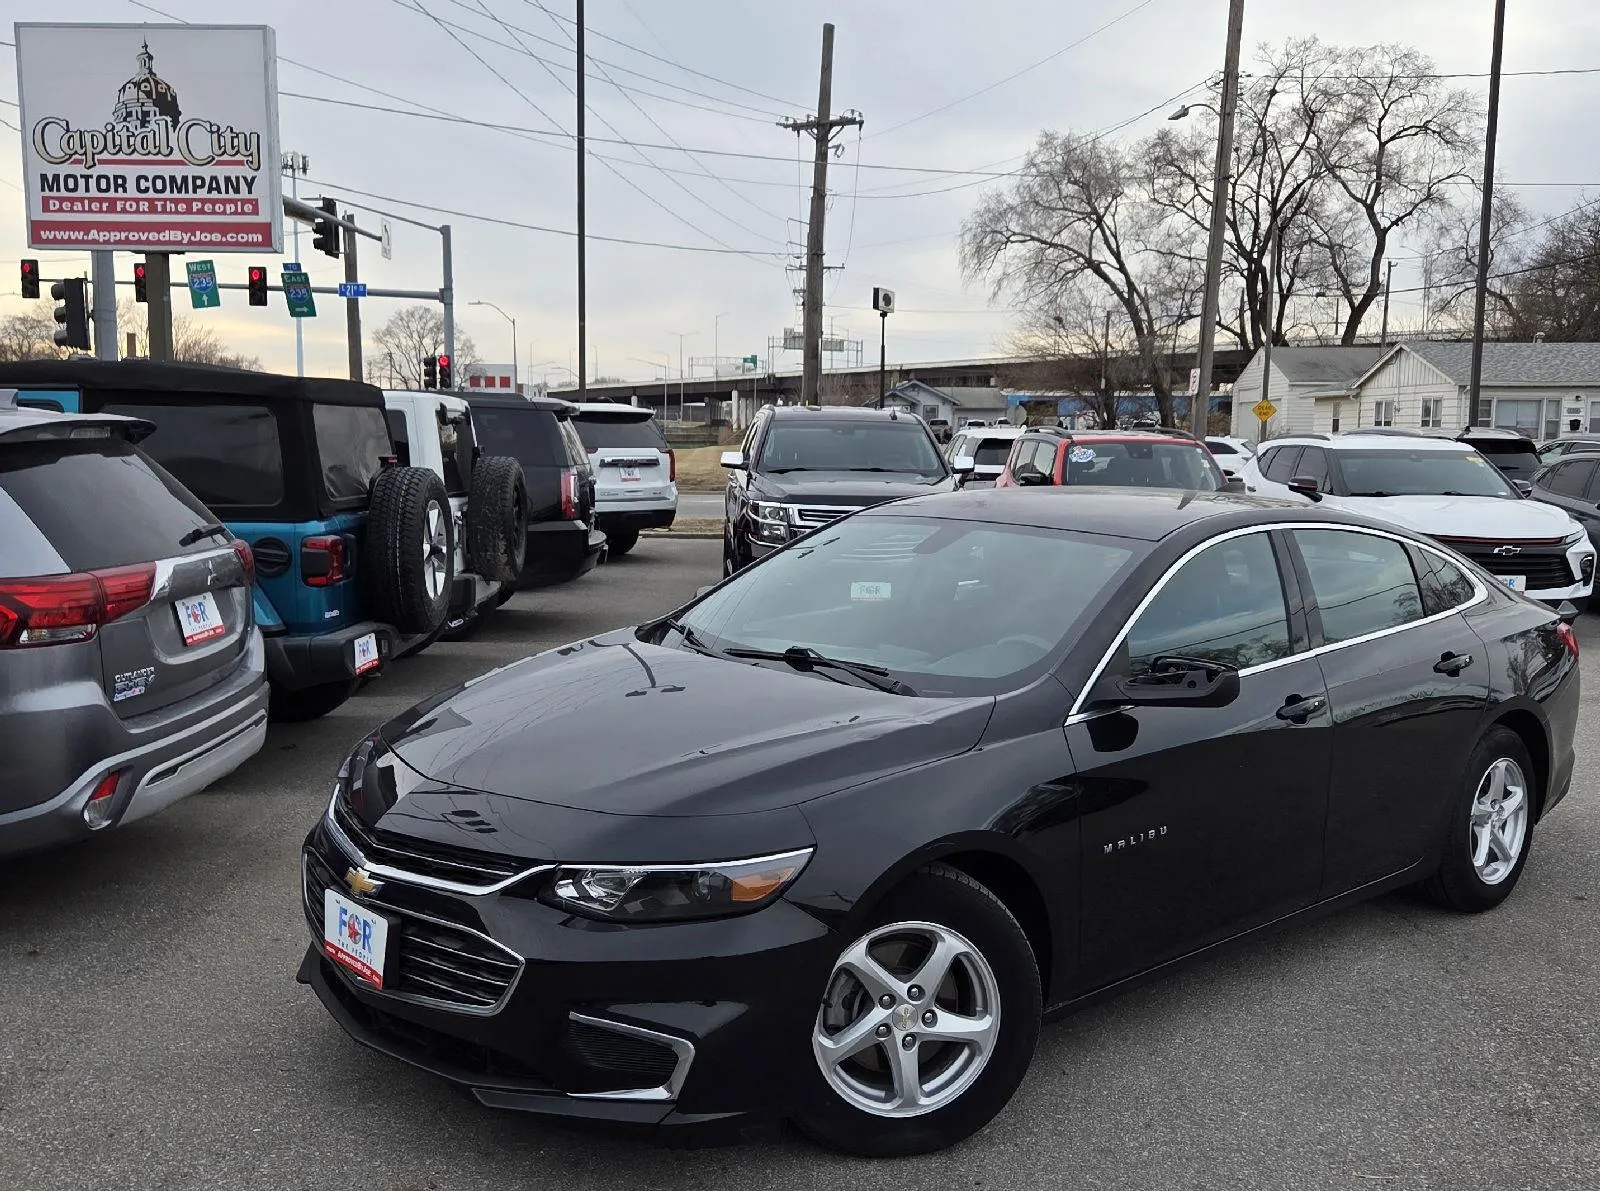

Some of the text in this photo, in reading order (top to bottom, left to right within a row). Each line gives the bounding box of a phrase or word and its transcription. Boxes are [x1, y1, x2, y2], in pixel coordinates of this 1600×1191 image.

[33, 116, 261, 170] Capital City
[40, 173, 257, 195] MOTOR COMPANY
[49, 199, 109, 211] Dealer
[116, 200, 149, 212] FOR
[155, 201, 187, 212] The
[40, 229, 263, 243] www.ApprovedByJoe.com
[193, 277, 213, 289] 235
[290, 288, 308, 298] 235
[185, 601, 210, 626] FOR
[1103, 826, 1167, 854] MALIBU
[339, 906, 372, 953] FOR
